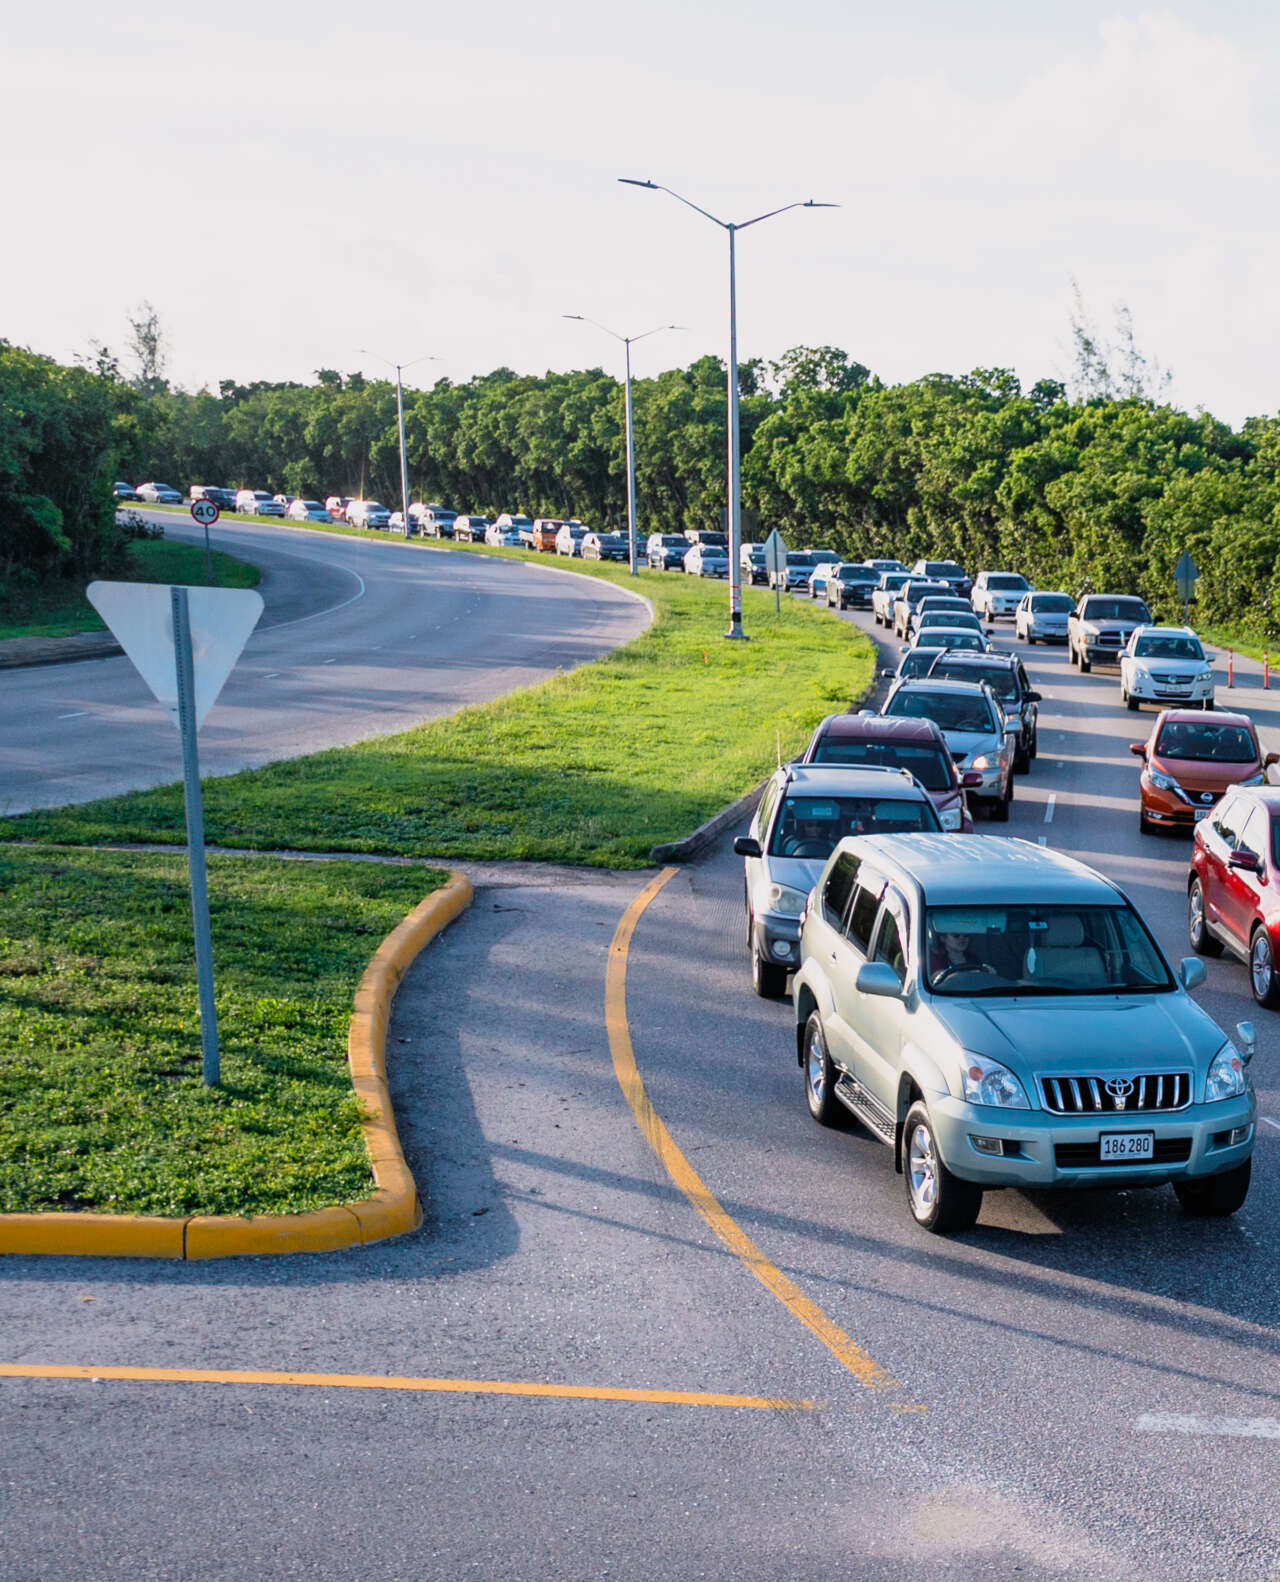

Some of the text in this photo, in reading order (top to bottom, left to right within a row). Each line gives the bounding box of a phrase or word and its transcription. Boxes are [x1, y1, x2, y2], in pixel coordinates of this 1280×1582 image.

[195, 506, 216, 517] 40
[1104, 1137, 1150, 1154] 186 280
